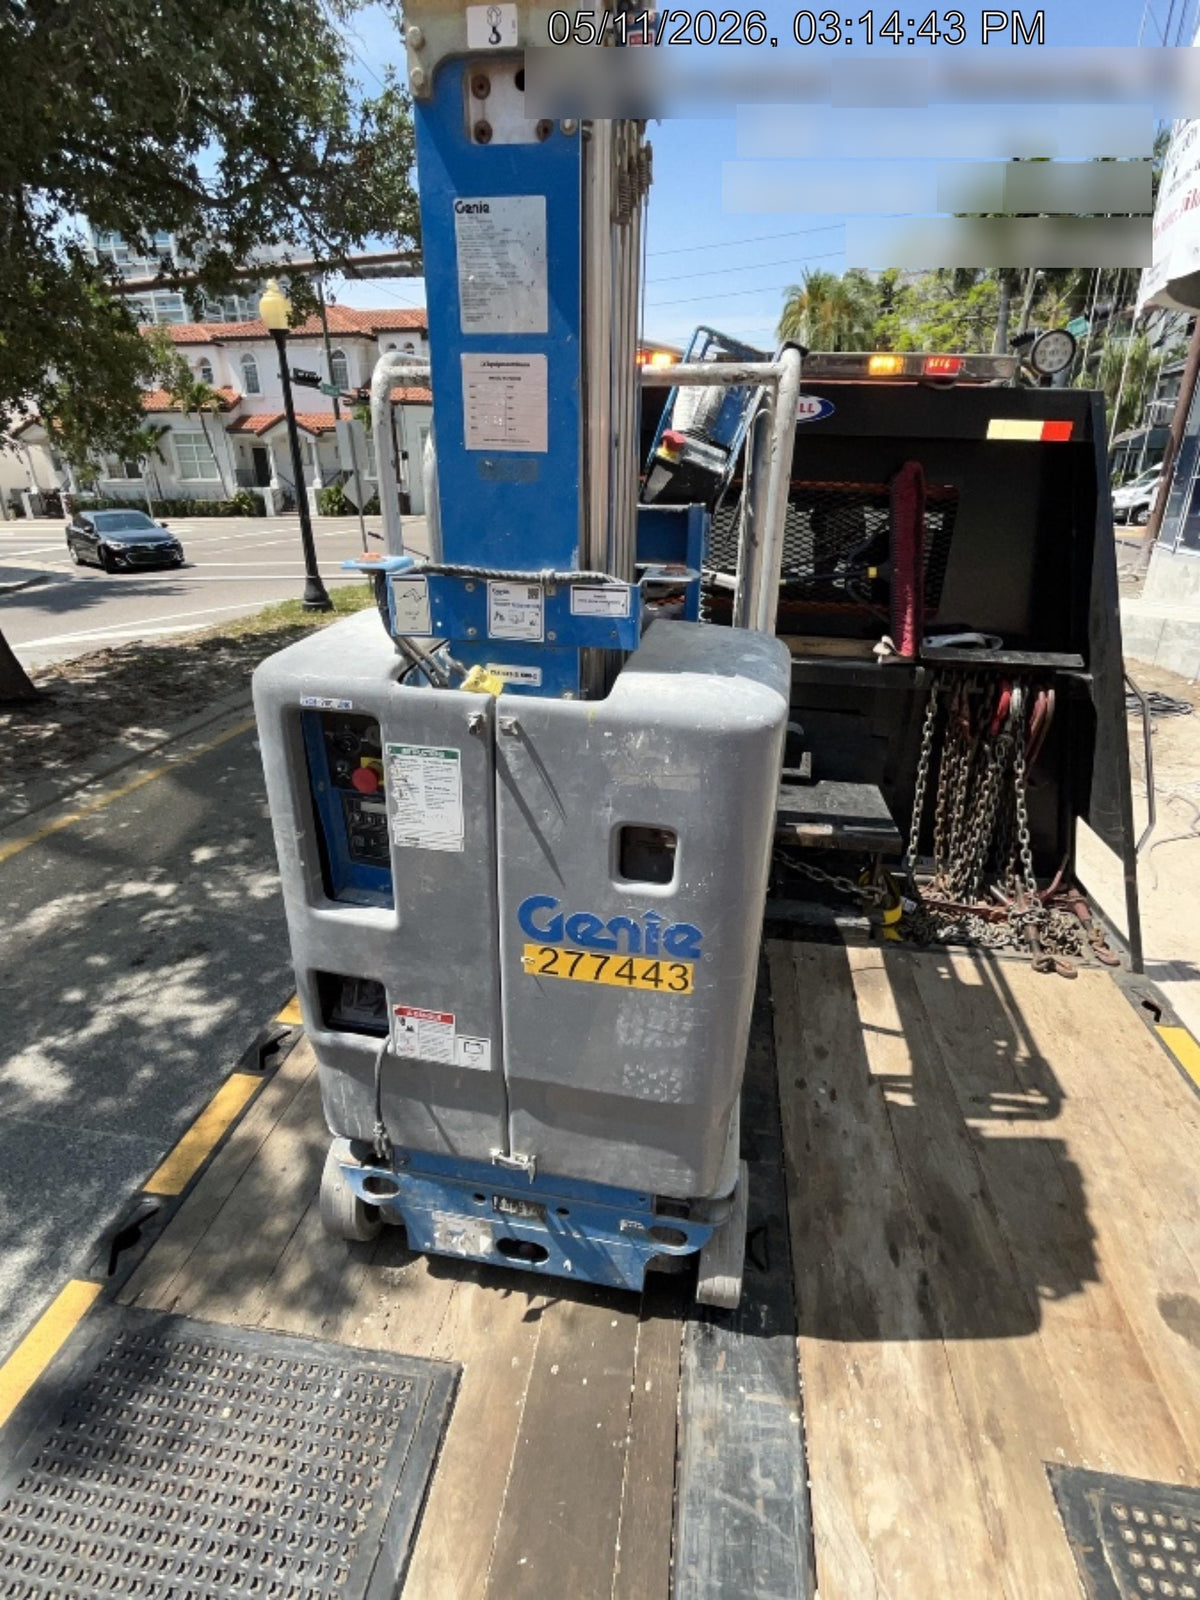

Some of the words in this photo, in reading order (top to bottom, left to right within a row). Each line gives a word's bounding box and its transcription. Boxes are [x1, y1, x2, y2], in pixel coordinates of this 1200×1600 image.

[454, 200, 490, 214] Genie
[517, 893, 704, 959] Genie
[538, 947, 689, 992] 277443
